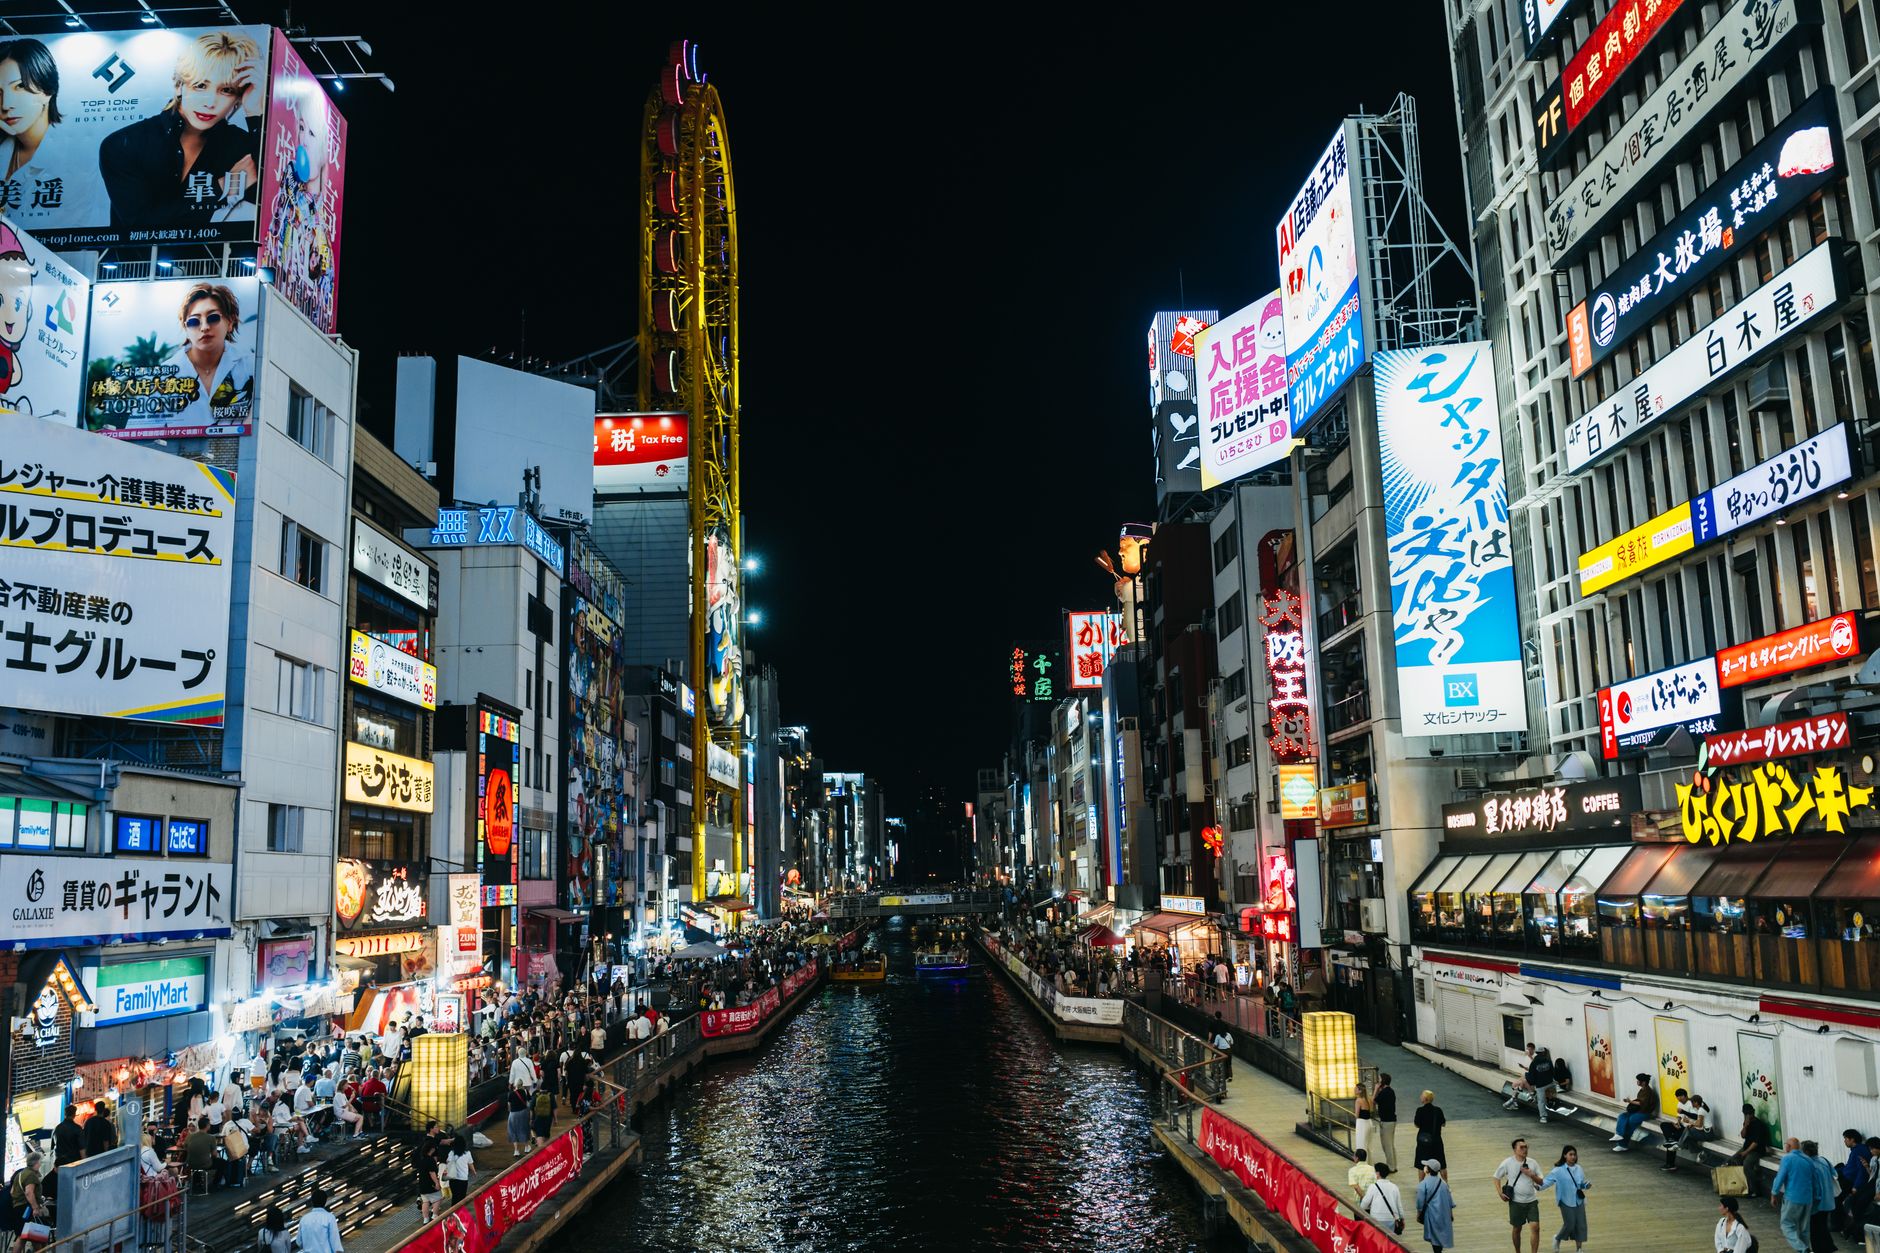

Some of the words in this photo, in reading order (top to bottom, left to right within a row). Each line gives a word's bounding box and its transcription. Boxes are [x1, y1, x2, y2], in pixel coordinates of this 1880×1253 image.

[81, 98, 139, 107] TOP1ONE
[1537, 95, 1562, 149] 7F
[1581, 36, 1736, 218] 完全個室居酒屋
[183, 169, 248, 202] 皐月
[1730, 162, 1774, 209] 黒毛和牛
[1618, 274, 1653, 316] 焼肉屋
[1654, 206, 1723, 295] 大牧場
[38, 328, 78, 361] 富士グループ
[1208, 323, 1257, 382] 入店
[1571, 314, 1586, 370] 5F
[91, 376, 196, 397] 体験入店大歓迎
[1209, 353, 1287, 422] 応援金
[1294, 326, 1359, 425] ガルフネット
[1568, 423, 1582, 448] 4F
[1587, 382, 1655, 457] 白木屋
[1706, 282, 1801, 377] 白木屋
[1211, 393, 1289, 444] プレゼント中!
[594, 428, 635, 452] 税
[641, 434, 659, 444] Tax
[661, 434, 684, 444] Free
[432, 508, 515, 543] 無双
[1697, 497, 1710, 540] 3F
[1076, 620, 1130, 647] かに
[1721, 656, 1748, 677] ダーツ
[1749, 653, 1758, 668] &
[1760, 632, 1830, 667] ダイニングバー
[1033, 654, 1052, 696] 千房
[1077, 651, 1112, 679] 道
[1258, 589, 1309, 757] 大阪王将
[1448, 681, 1474, 698] BX
[1423, 709, 1507, 725] 文化シャッター
[1602, 699, 1614, 749] 2F
[1708, 717, 1847, 761] ハンバーグレストラン
[360, 754, 413, 804] うなぎ
[1447, 812, 1476, 829] HOSHINO
[1483, 786, 1568, 835] 星乃珈琲店
[1582, 792, 1620, 813] COFFEE
[1674, 761, 1876, 847] びっくりドンキー
[128, 821, 141, 848] 酒
[169, 824, 196, 850] たばこ
[12, 907, 55, 921] GALAXIE
[61, 869, 221, 920] 賃貸のギャラント
[459, 933, 476, 942] ZUN
[116, 981, 188, 1013] FamilyMart
[1595, 1049, 1606, 1060] BBQ
[1667, 1068, 1680, 1080] BBQ
[1752, 1088, 1768, 1102] BBQ
